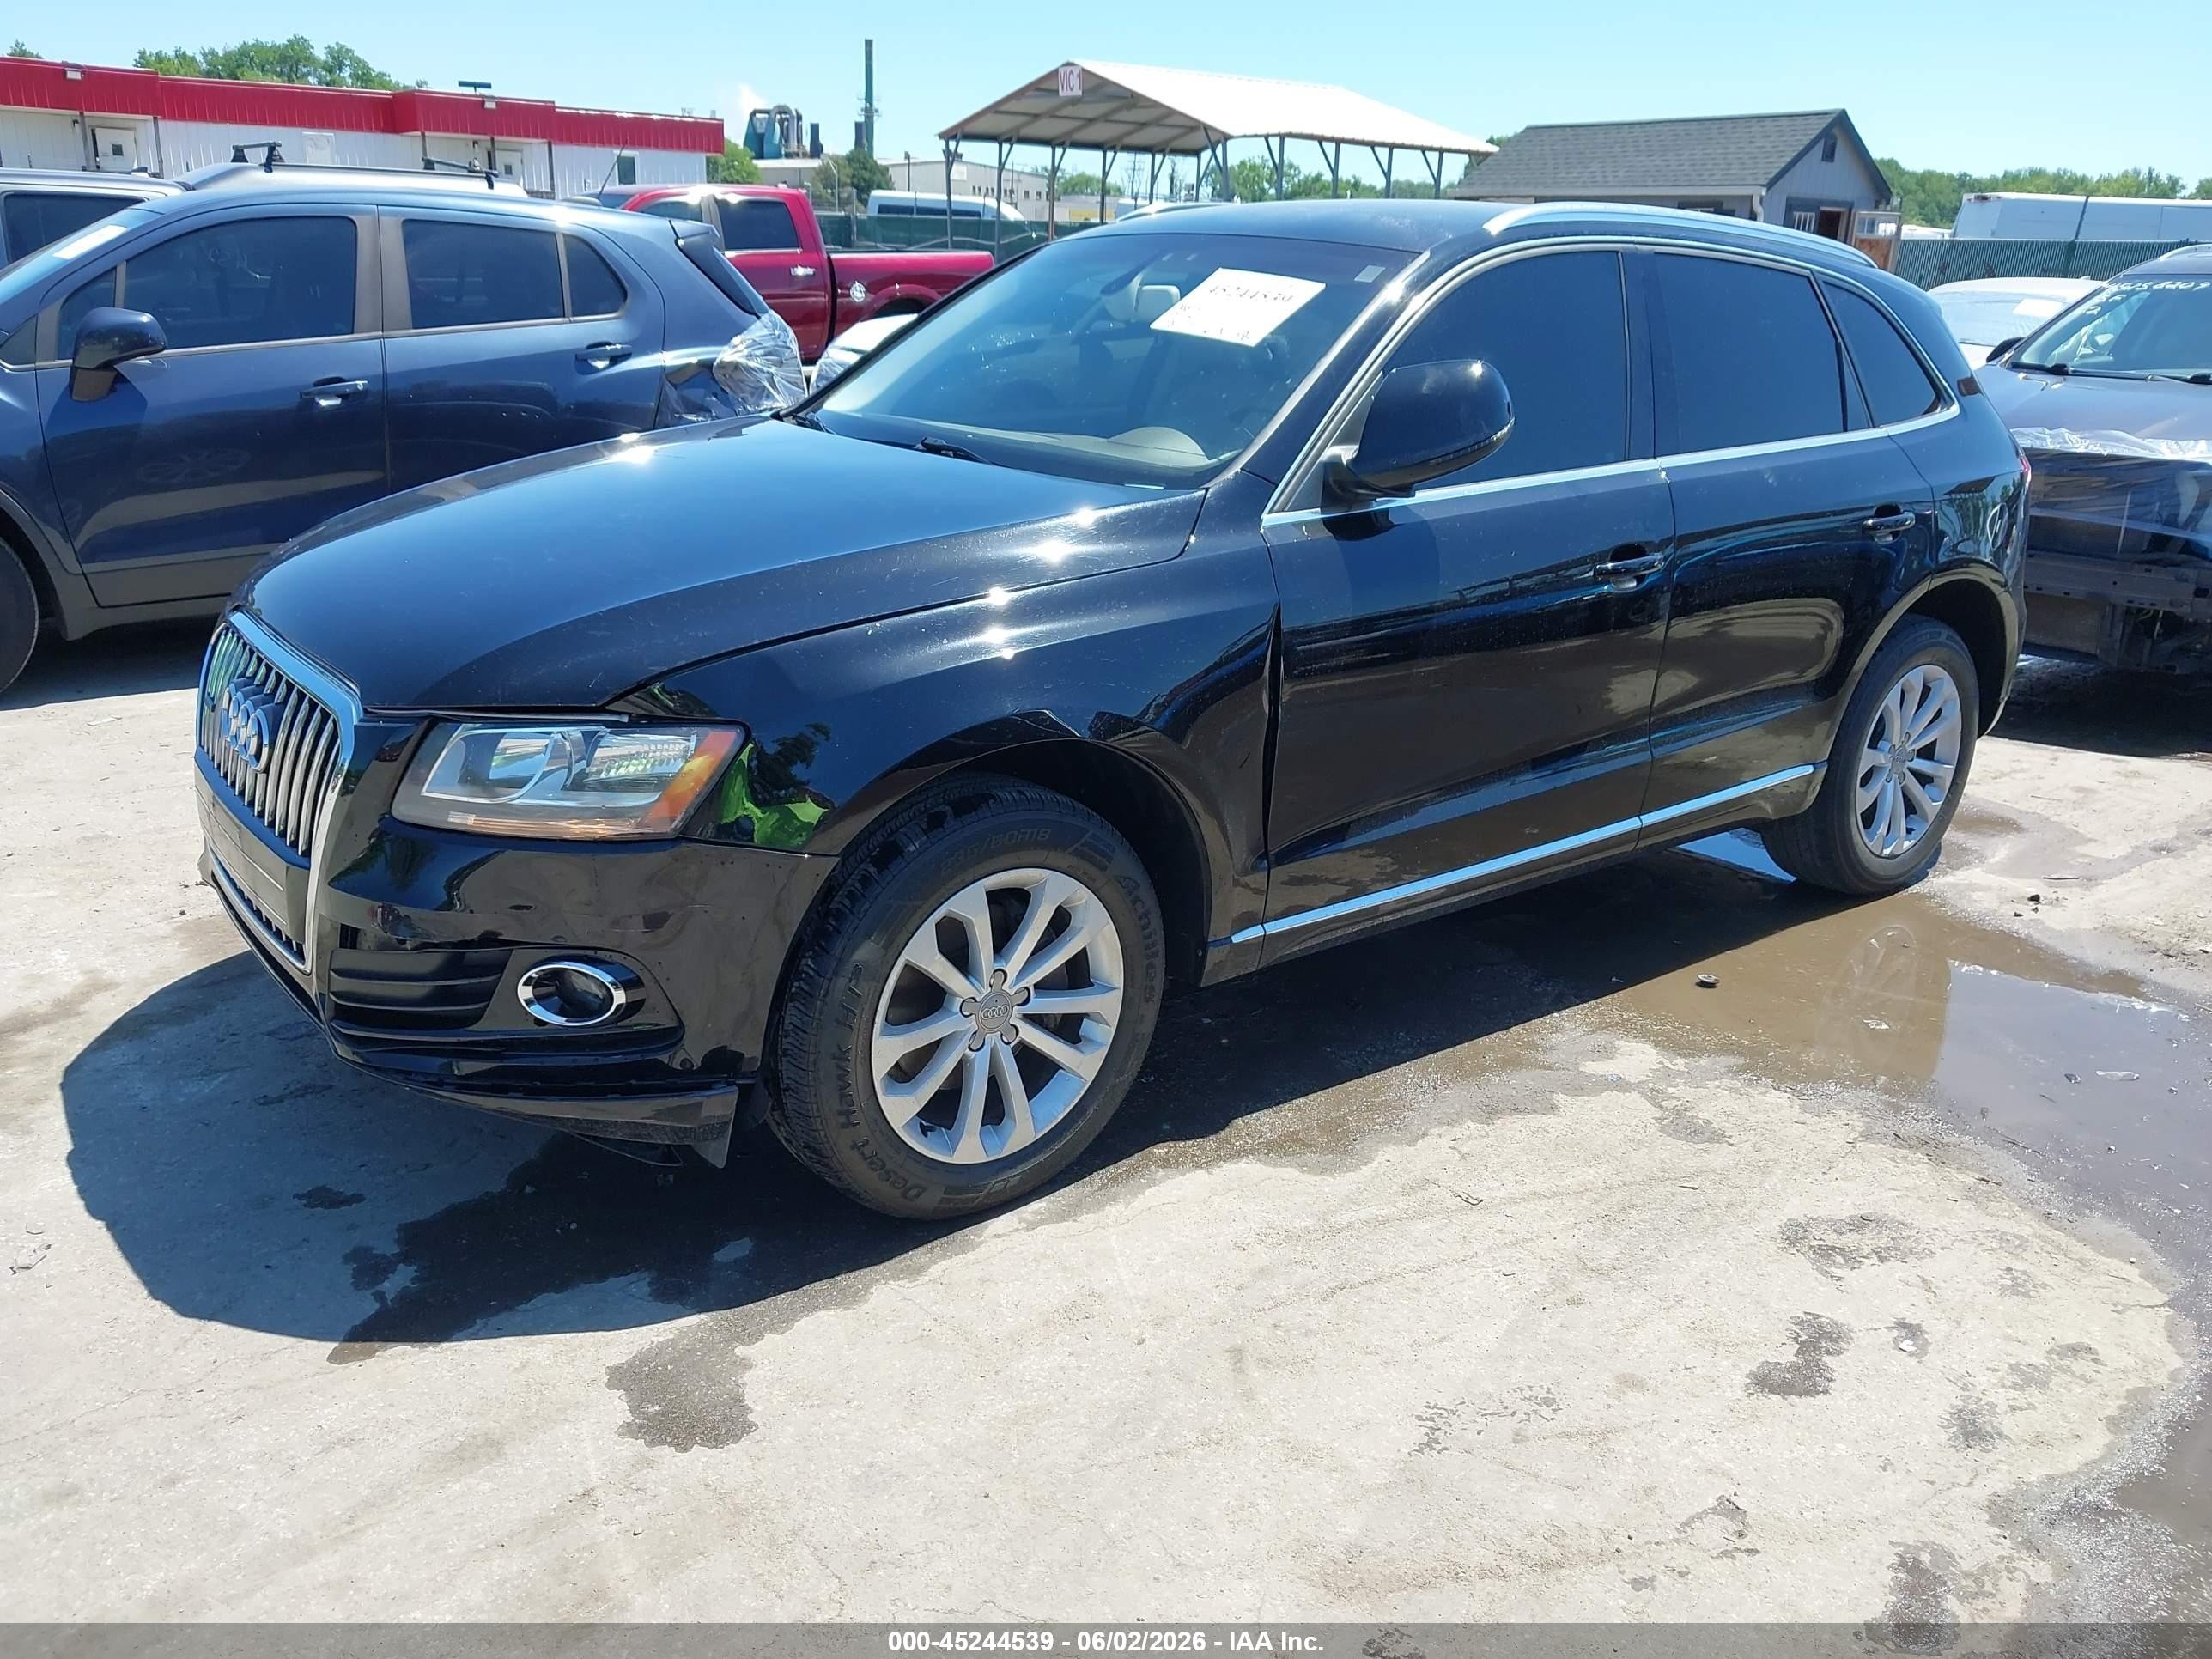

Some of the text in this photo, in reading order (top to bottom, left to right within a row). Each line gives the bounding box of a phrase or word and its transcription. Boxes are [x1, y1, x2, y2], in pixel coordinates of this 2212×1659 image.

[1059, 69, 1082, 92] VIC 1
[831, 1043, 860, 1129] Hawk
[851, 1136, 927, 1201] Desert
